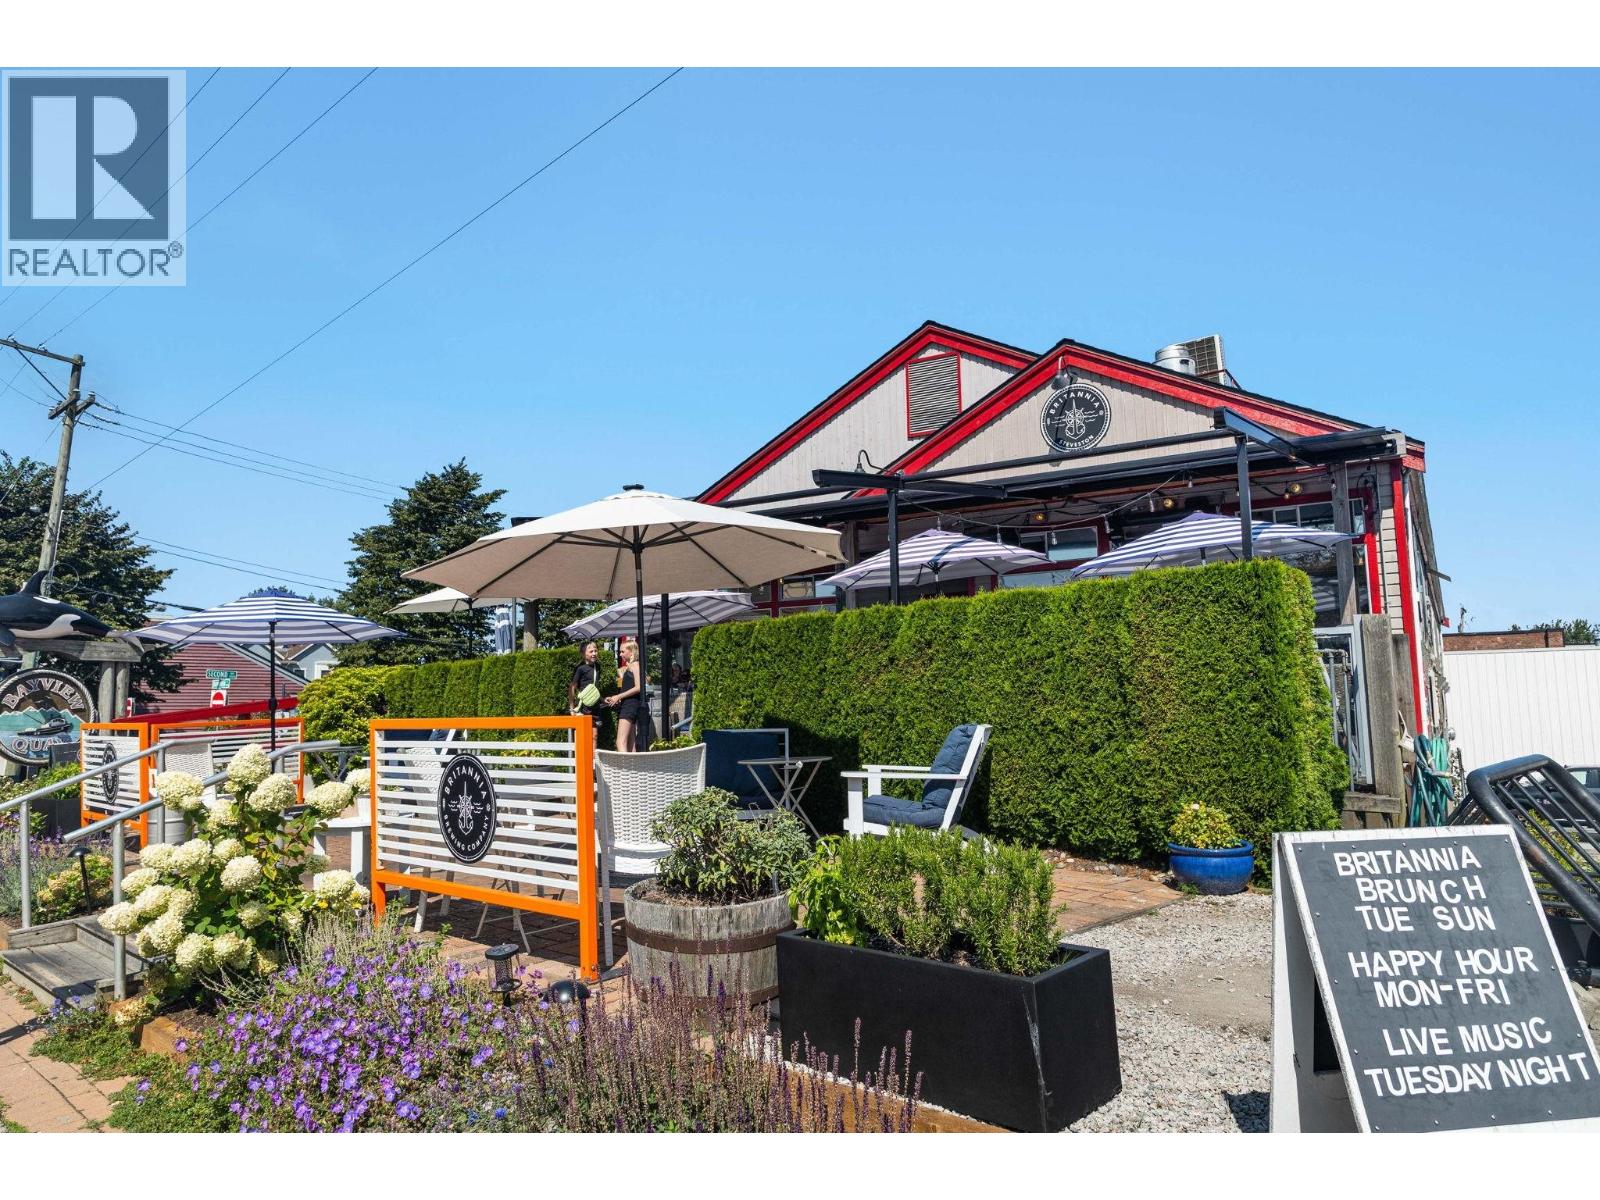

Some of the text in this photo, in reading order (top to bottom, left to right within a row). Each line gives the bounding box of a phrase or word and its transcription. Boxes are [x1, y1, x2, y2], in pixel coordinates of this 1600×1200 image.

[1049, 391, 1100, 415] BRITANNIA
[1059, 434, 1094, 448] STEVESTON
[207, 670, 229, 679] SECOND
[1, 677, 85, 710] BAYVIEW
[12, 736, 63, 755] QUA
[444, 765, 488, 799] BRITANNIA
[443, 814, 489, 852] BREWING COMPANY
[1333, 845, 1483, 876] BRITANNIA
[1356, 875, 1487, 904] BRUNCH
[1354, 905, 1497, 933] TUE SUN
[1348, 946, 1539, 978] HAPPY HOUR
[1373, 979, 1511, 1008] MON-FRI
[1382, 1016, 1553, 1057] LIVE MUSIC
[1363, 1052, 1591, 1098] TUESDAY NIGHT
